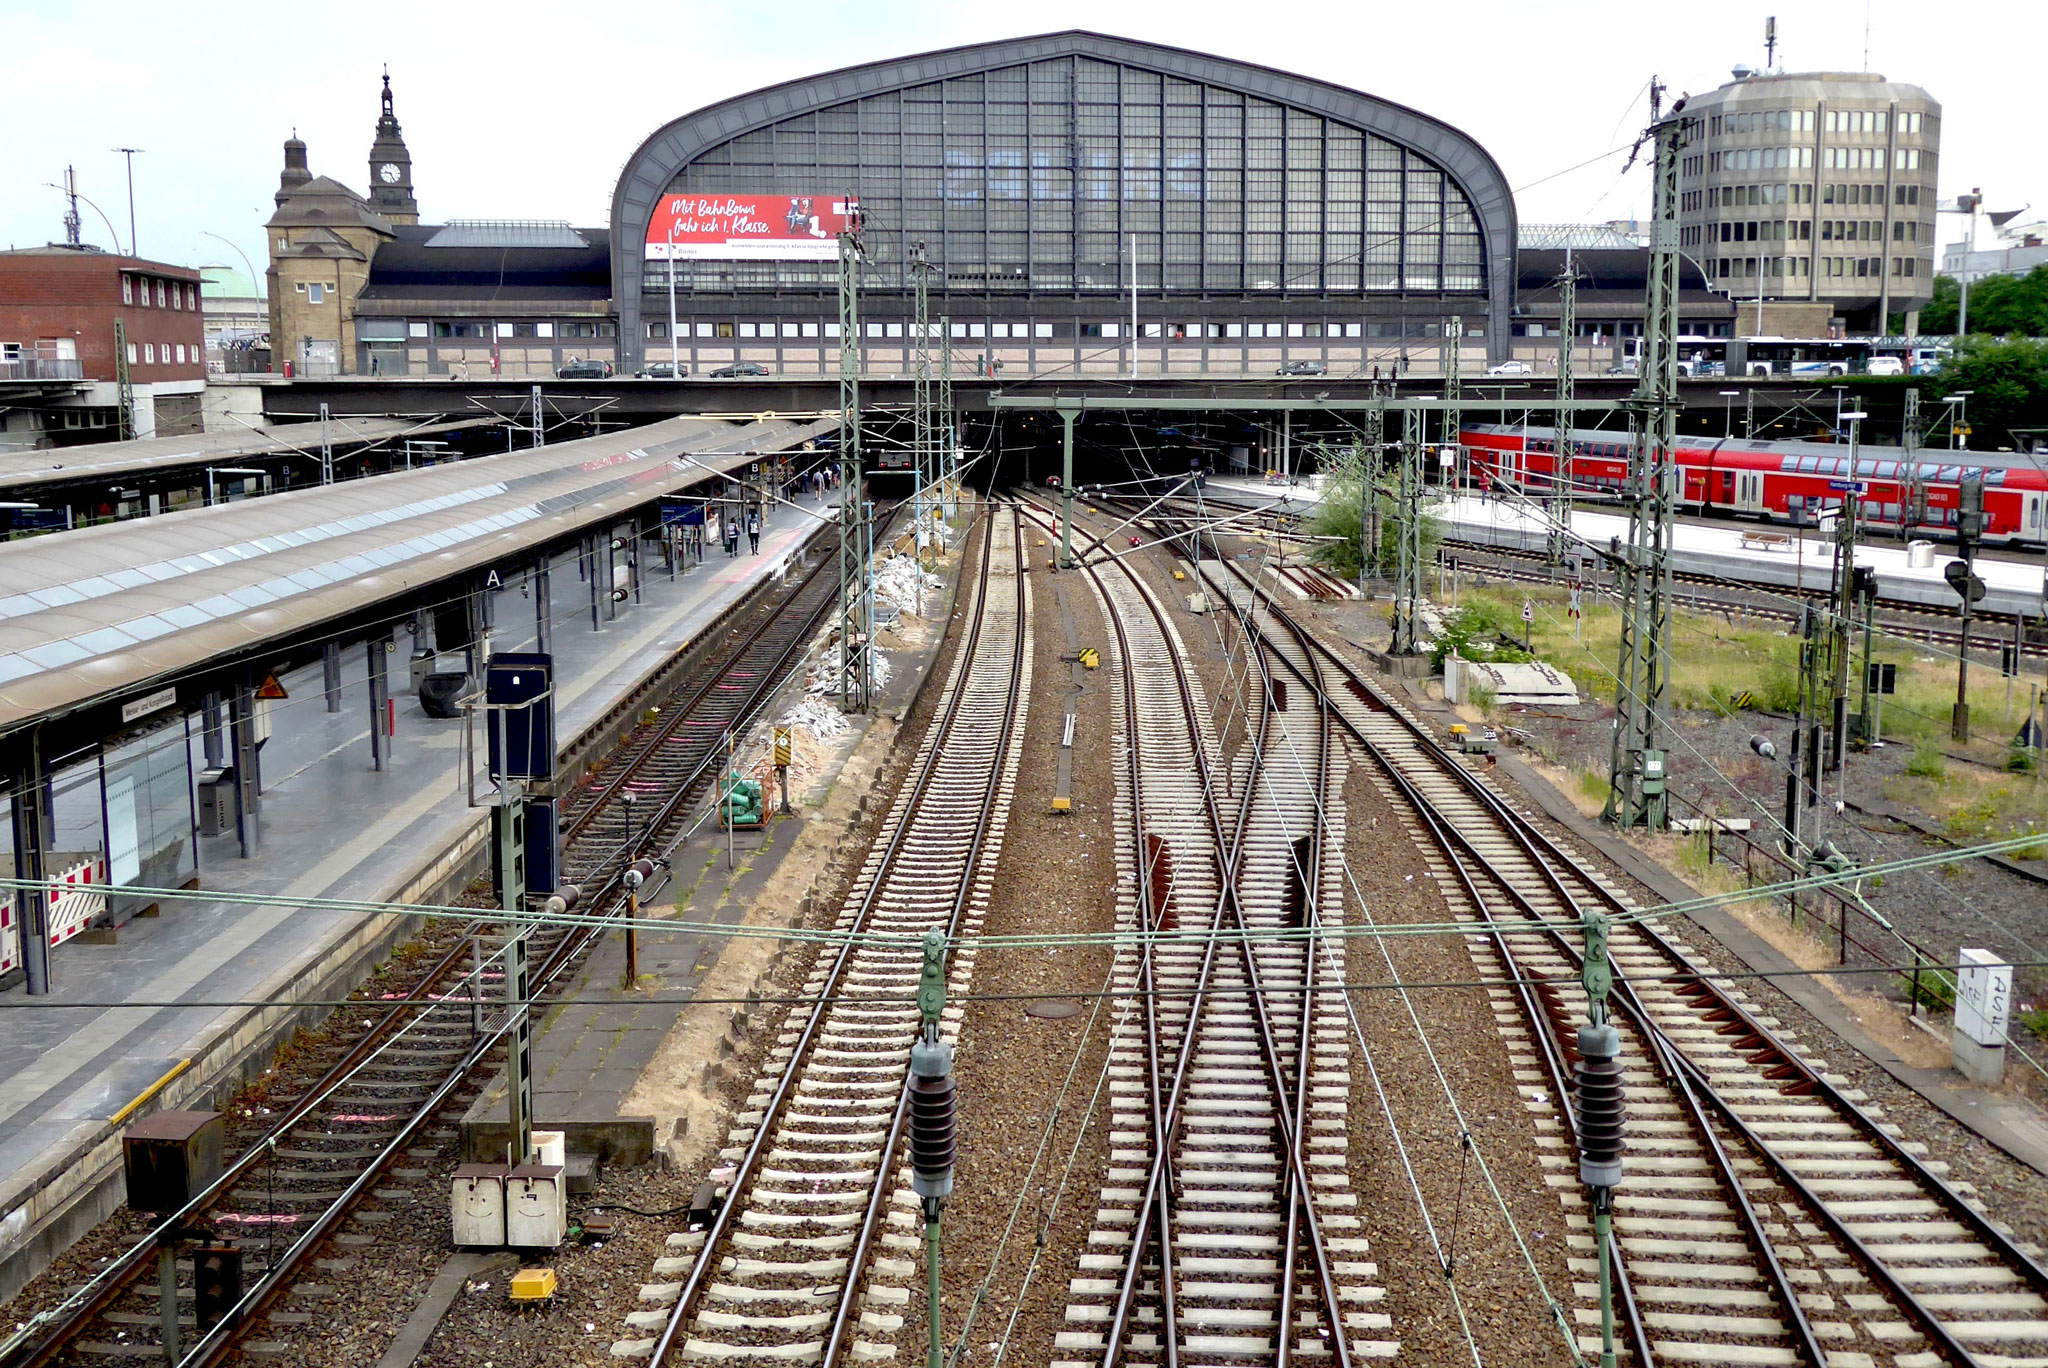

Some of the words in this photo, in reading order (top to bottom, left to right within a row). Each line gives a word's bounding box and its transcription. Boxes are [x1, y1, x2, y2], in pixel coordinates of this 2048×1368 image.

[671, 199, 696, 215] Mit
[698, 199, 756, 217] BahnBonus
[674, 216, 699, 237] fahr
[701, 217, 719, 233] ich
[723, 220, 729, 234] 1.
[732, 215, 771, 236] Klasse.
[809, 215, 827, 239] 1.
[283, 465, 290, 475] B
[752, 463, 759, 473] B
[487, 569, 501, 587] A
[1484, 731, 1497, 739] 235
